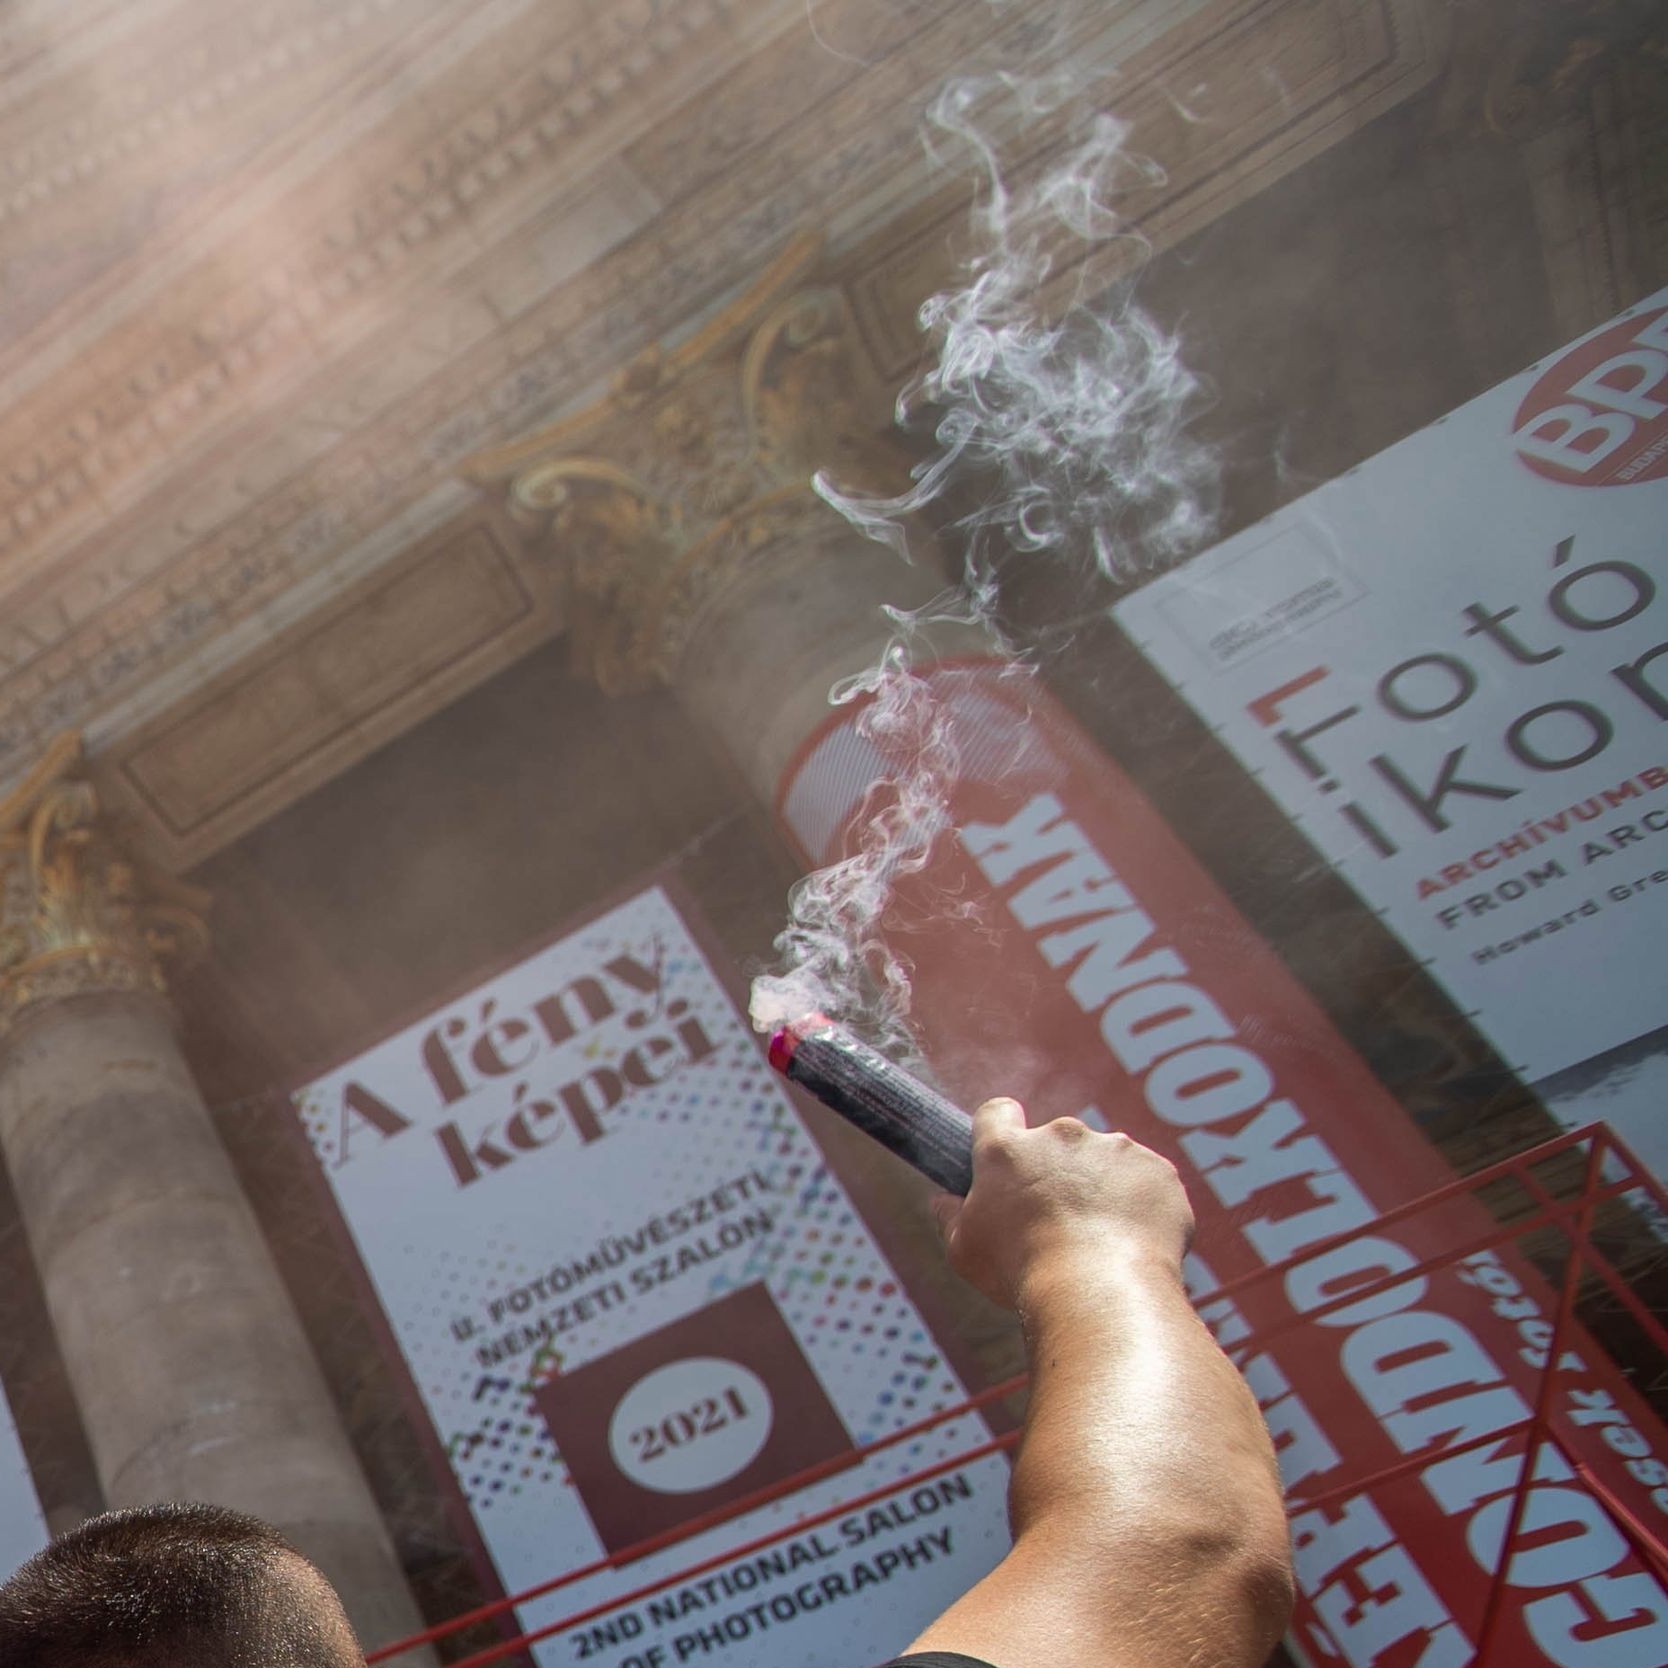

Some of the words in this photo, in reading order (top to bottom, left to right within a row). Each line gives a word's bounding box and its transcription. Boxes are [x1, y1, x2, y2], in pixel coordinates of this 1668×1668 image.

[1244, 534, 1657, 780] Fotó
[1434, 859, 1567, 932] FROM
[1469, 900, 1601, 966] Howard
[316, 1079, 416, 1170] A
[416, 930, 676, 1108] fény
[435, 997, 727, 1189] képei
[476, 1284, 626, 1368] NEMZETI
[628, 1385, 752, 1463] 2021
[570, 1606, 644, 1662] 2ND
[648, 1527, 840, 1627] NATIONAL
[841, 1472, 974, 1546] SALON
[671, 1526, 958, 1662] PHOTOGRAPHY
